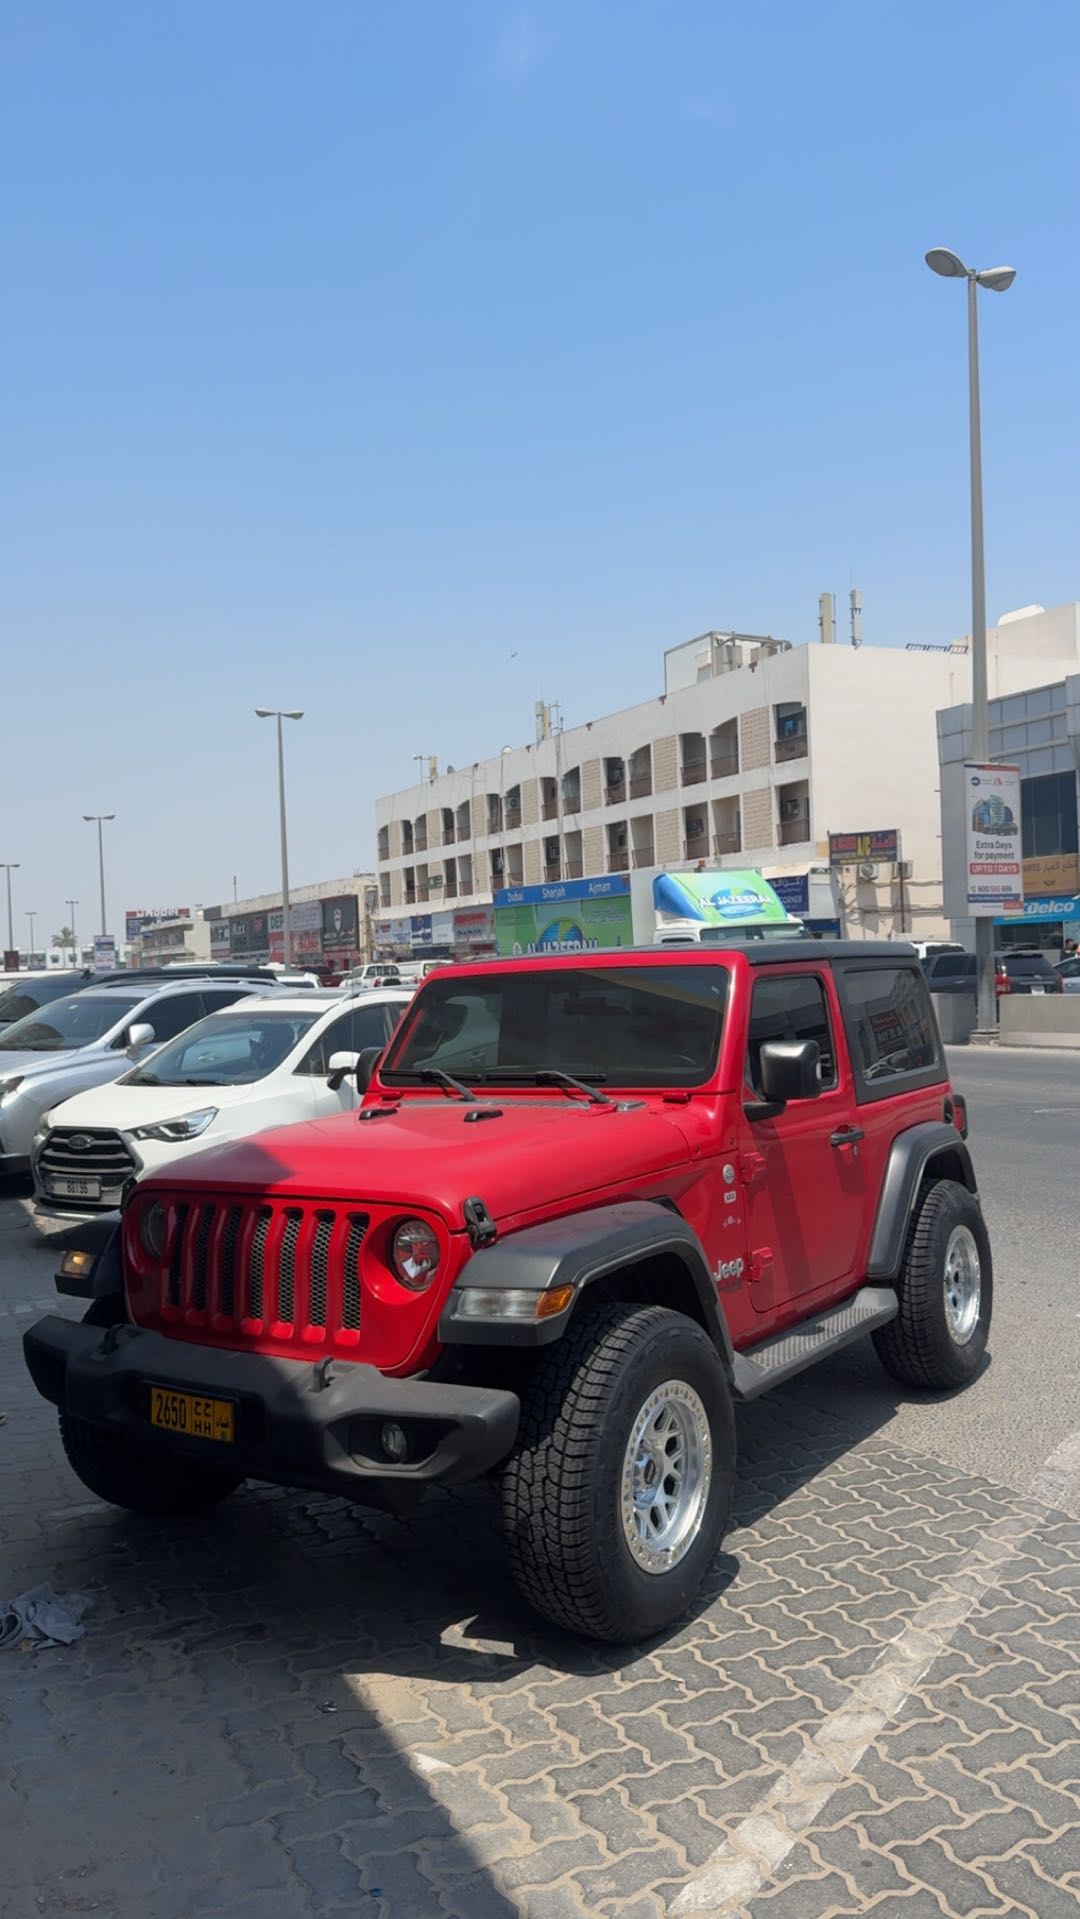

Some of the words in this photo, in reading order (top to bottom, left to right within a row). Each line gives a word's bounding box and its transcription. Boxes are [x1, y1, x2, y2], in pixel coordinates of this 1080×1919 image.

[976, 841, 994, 849] Extra
[995, 841, 1012, 851] Days
[974, 852, 984, 860] for
[984, 852, 1015, 861] payment
[998, 864, 1017, 873] DAYS
[507, 892, 524, 903] Dubai
[542, 886, 566, 900] Sharjah
[588, 882, 611, 896] Ajman
[699, 896, 716, 907] AL
[1023, 900, 1075, 914] Delco
[713, 1257, 744, 1282] Jeep
[156, 1394, 187, 1429] 2650
